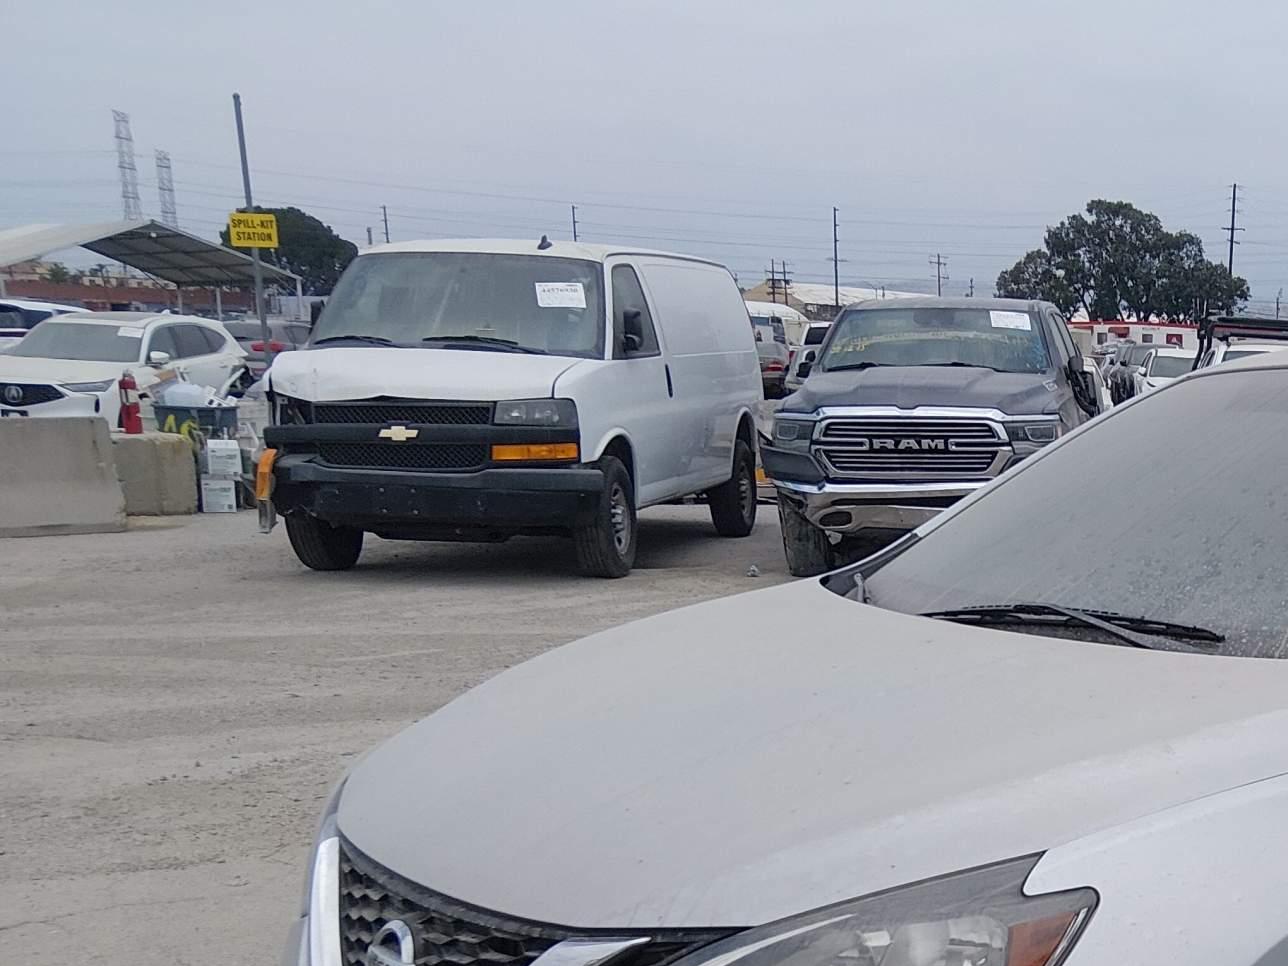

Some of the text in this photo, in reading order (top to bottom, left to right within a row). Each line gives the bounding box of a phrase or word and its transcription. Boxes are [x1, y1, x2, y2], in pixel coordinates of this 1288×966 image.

[231, 218, 274, 229] SPILL-KIT
[236, 231, 273, 242] STATION
[872, 438, 945, 450] RAM
